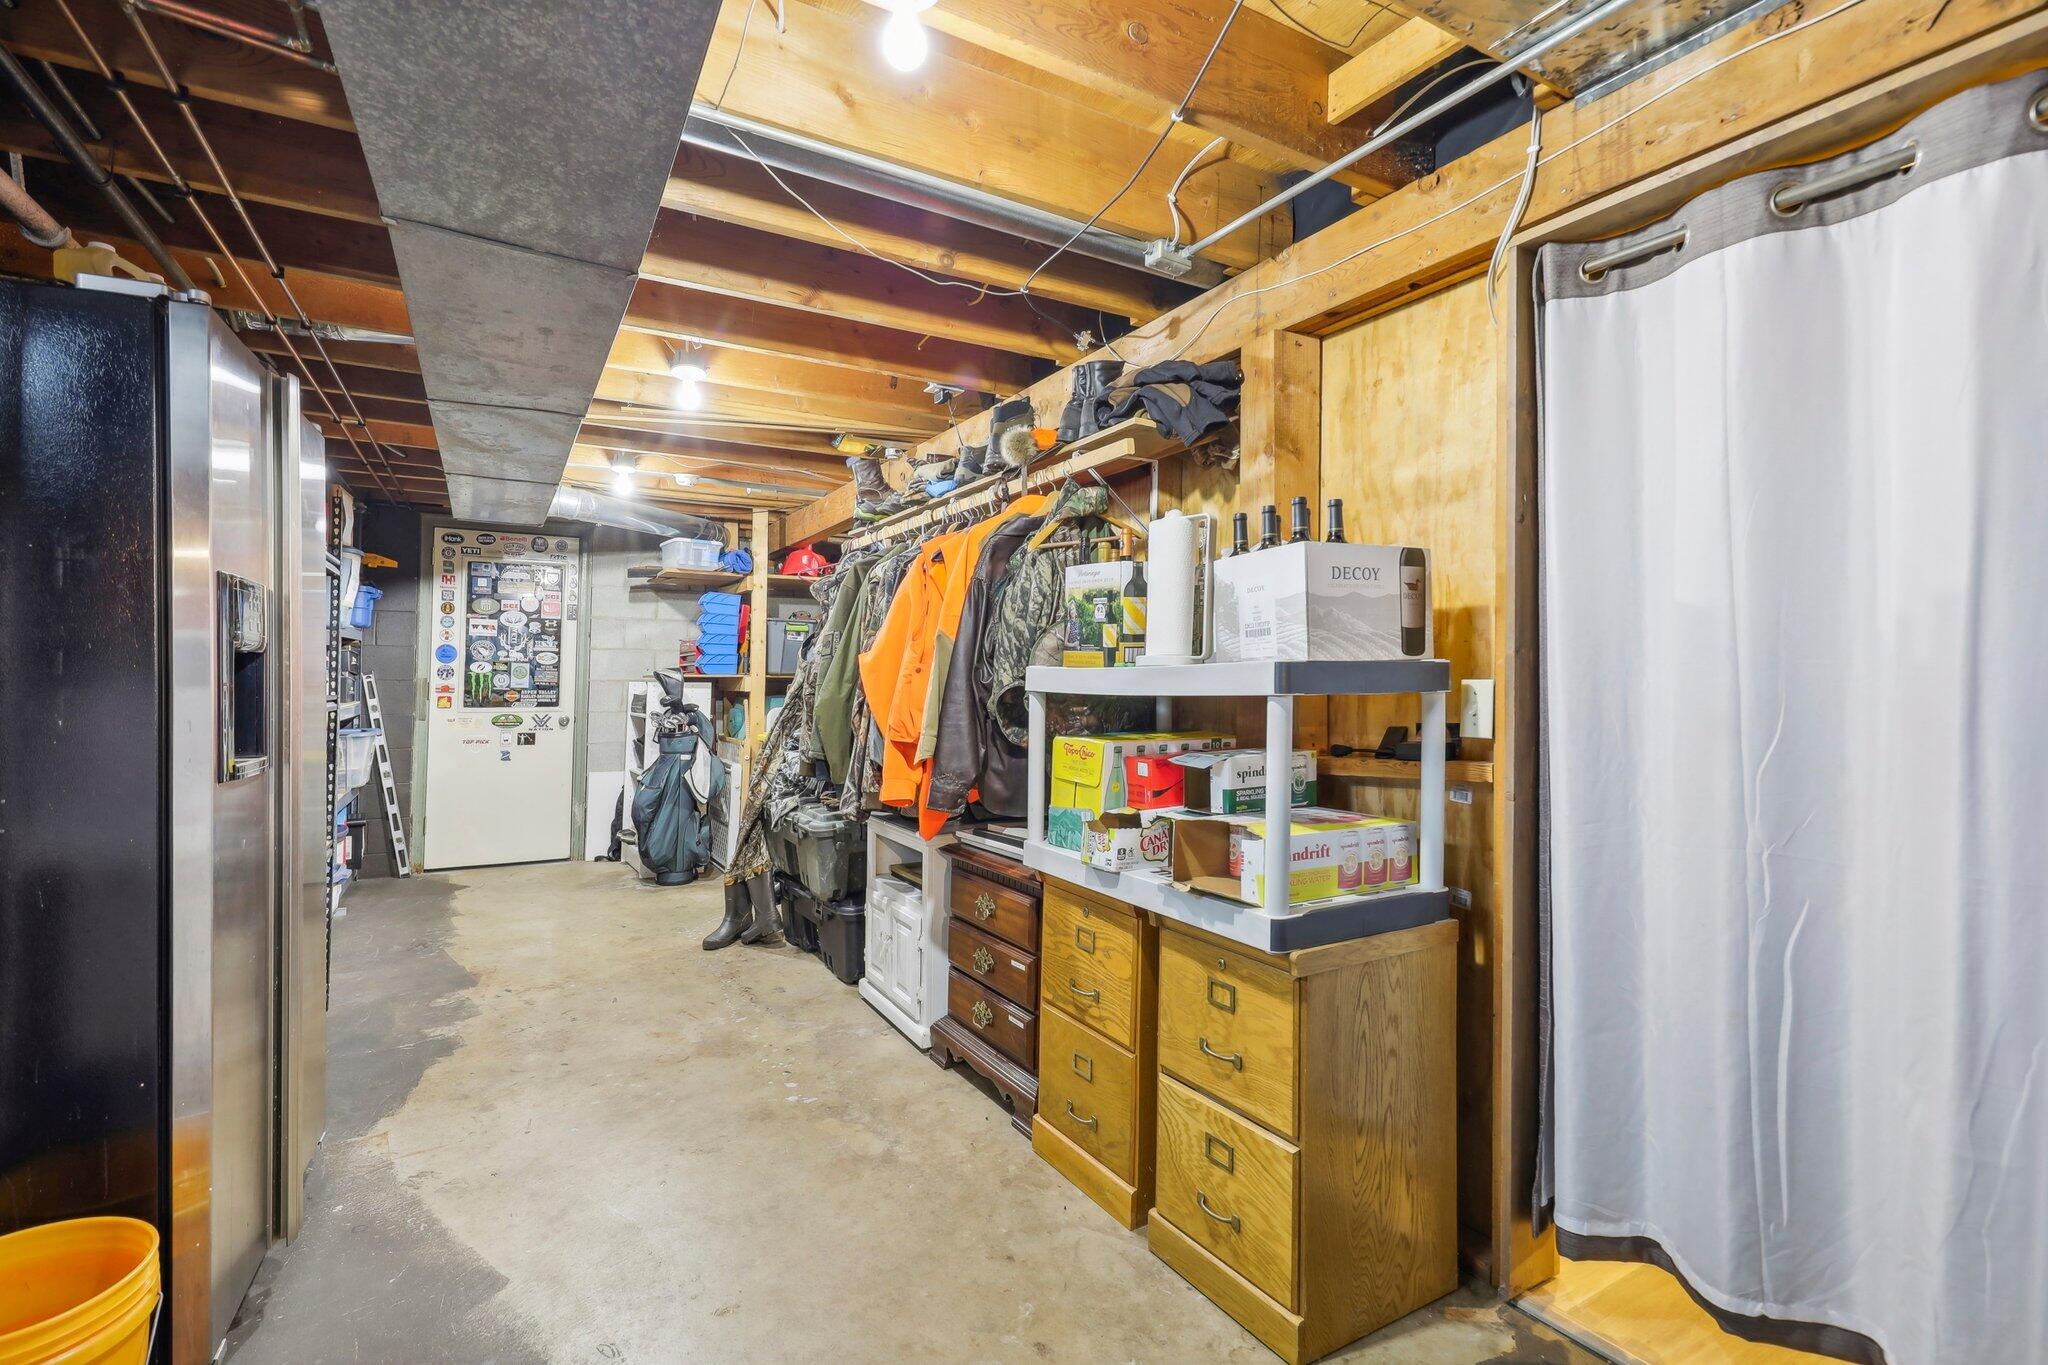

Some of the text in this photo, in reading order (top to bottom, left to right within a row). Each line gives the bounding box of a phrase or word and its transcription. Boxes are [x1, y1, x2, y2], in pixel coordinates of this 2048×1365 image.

[1331, 565, 1380, 581] DECOY
[1063, 742, 1096, 760] Topo Chico
[1236, 765, 1266, 783] spind
[1236, 787, 1265, 797] SPARKLING
[1140, 828, 1170, 852] CANA
[1290, 843, 1331, 861] ndrift
